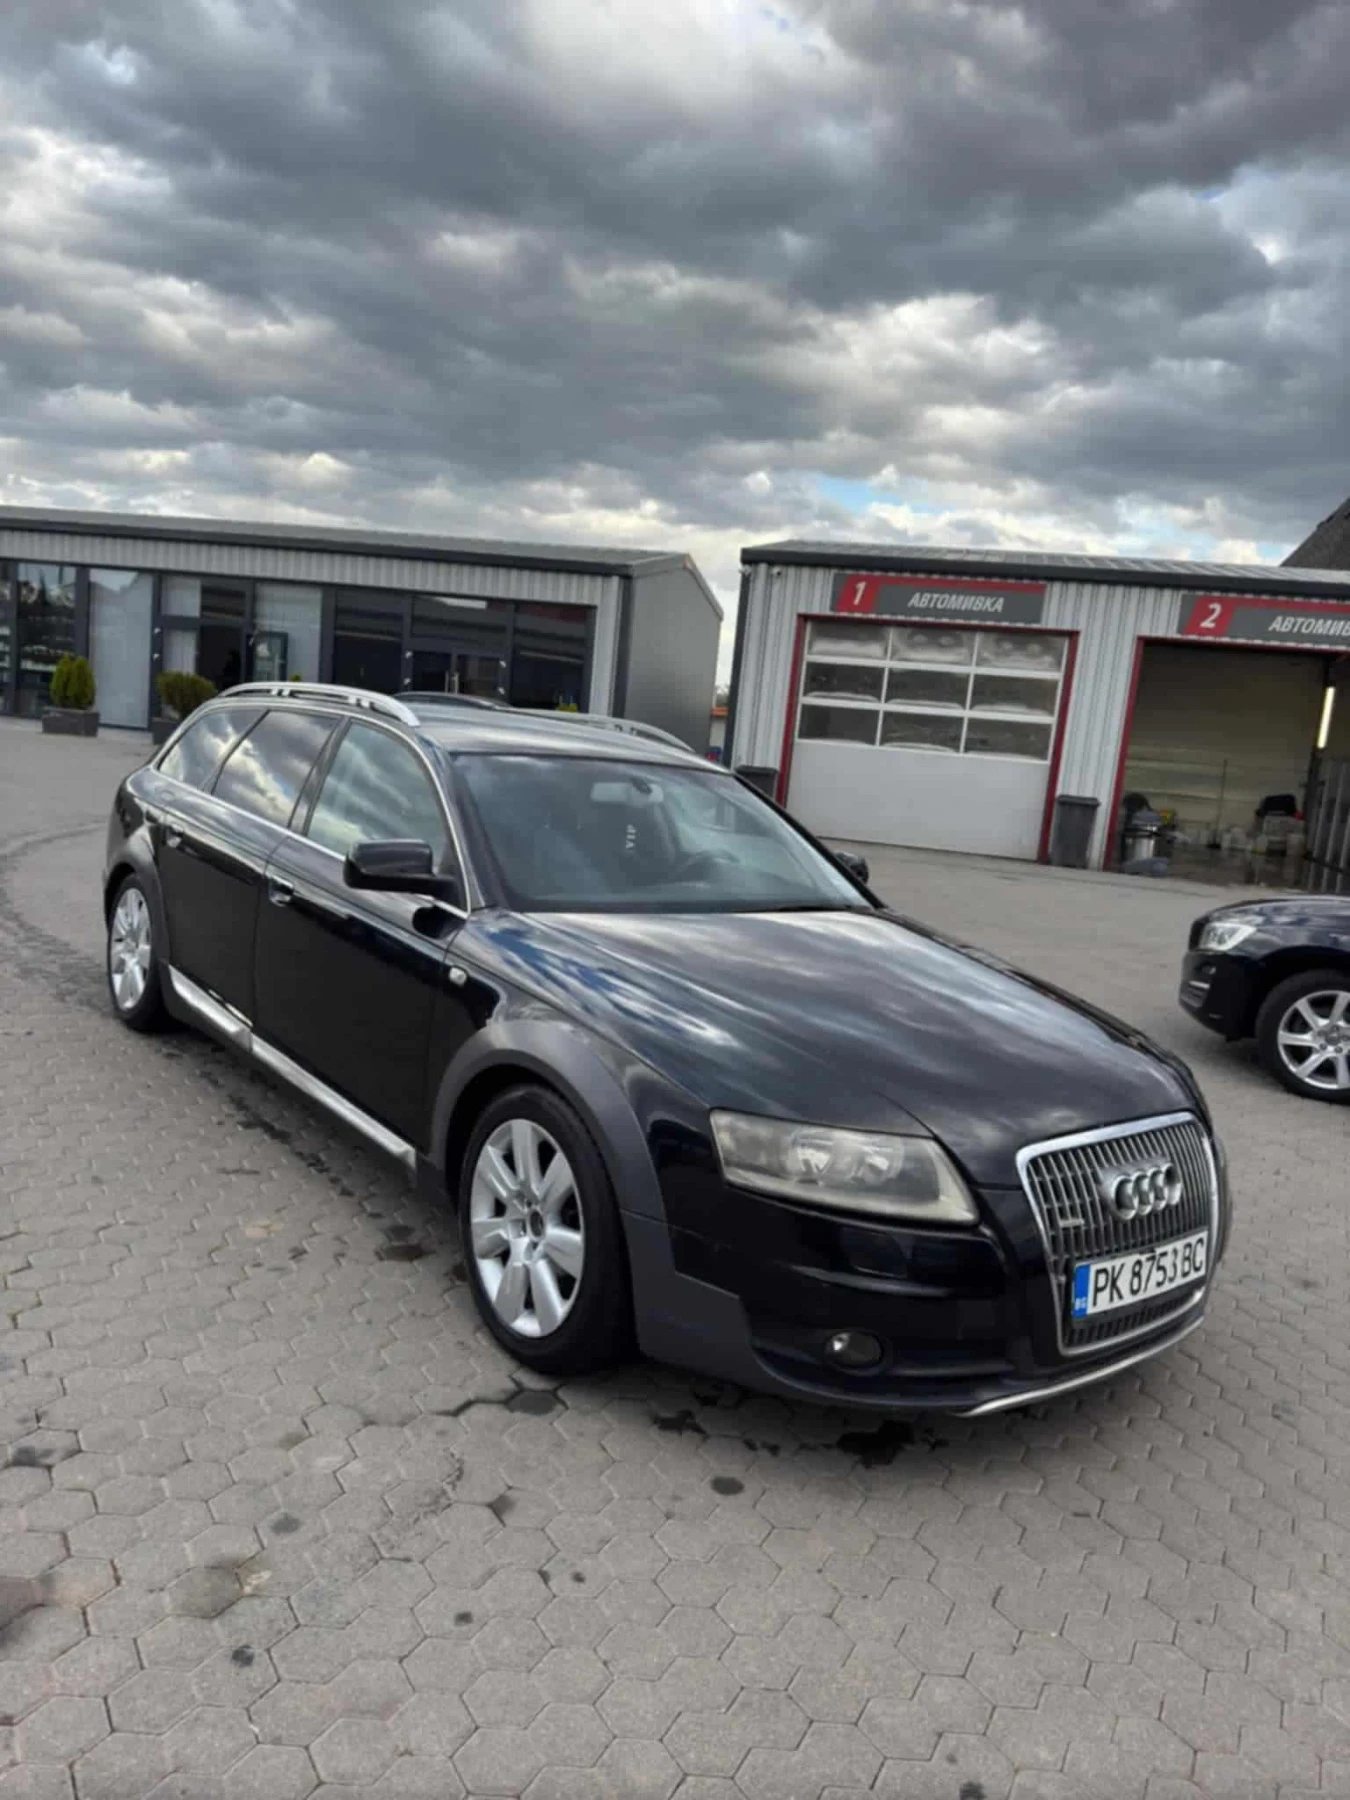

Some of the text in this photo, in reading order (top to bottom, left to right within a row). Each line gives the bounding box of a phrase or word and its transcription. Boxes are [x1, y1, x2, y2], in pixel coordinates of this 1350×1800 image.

[853, 581, 1005, 612] 1 АВТОМИВКА
[1199, 602, 1222, 629] 2
[1093, 1237, 1204, 1307] PK 8753 BC
